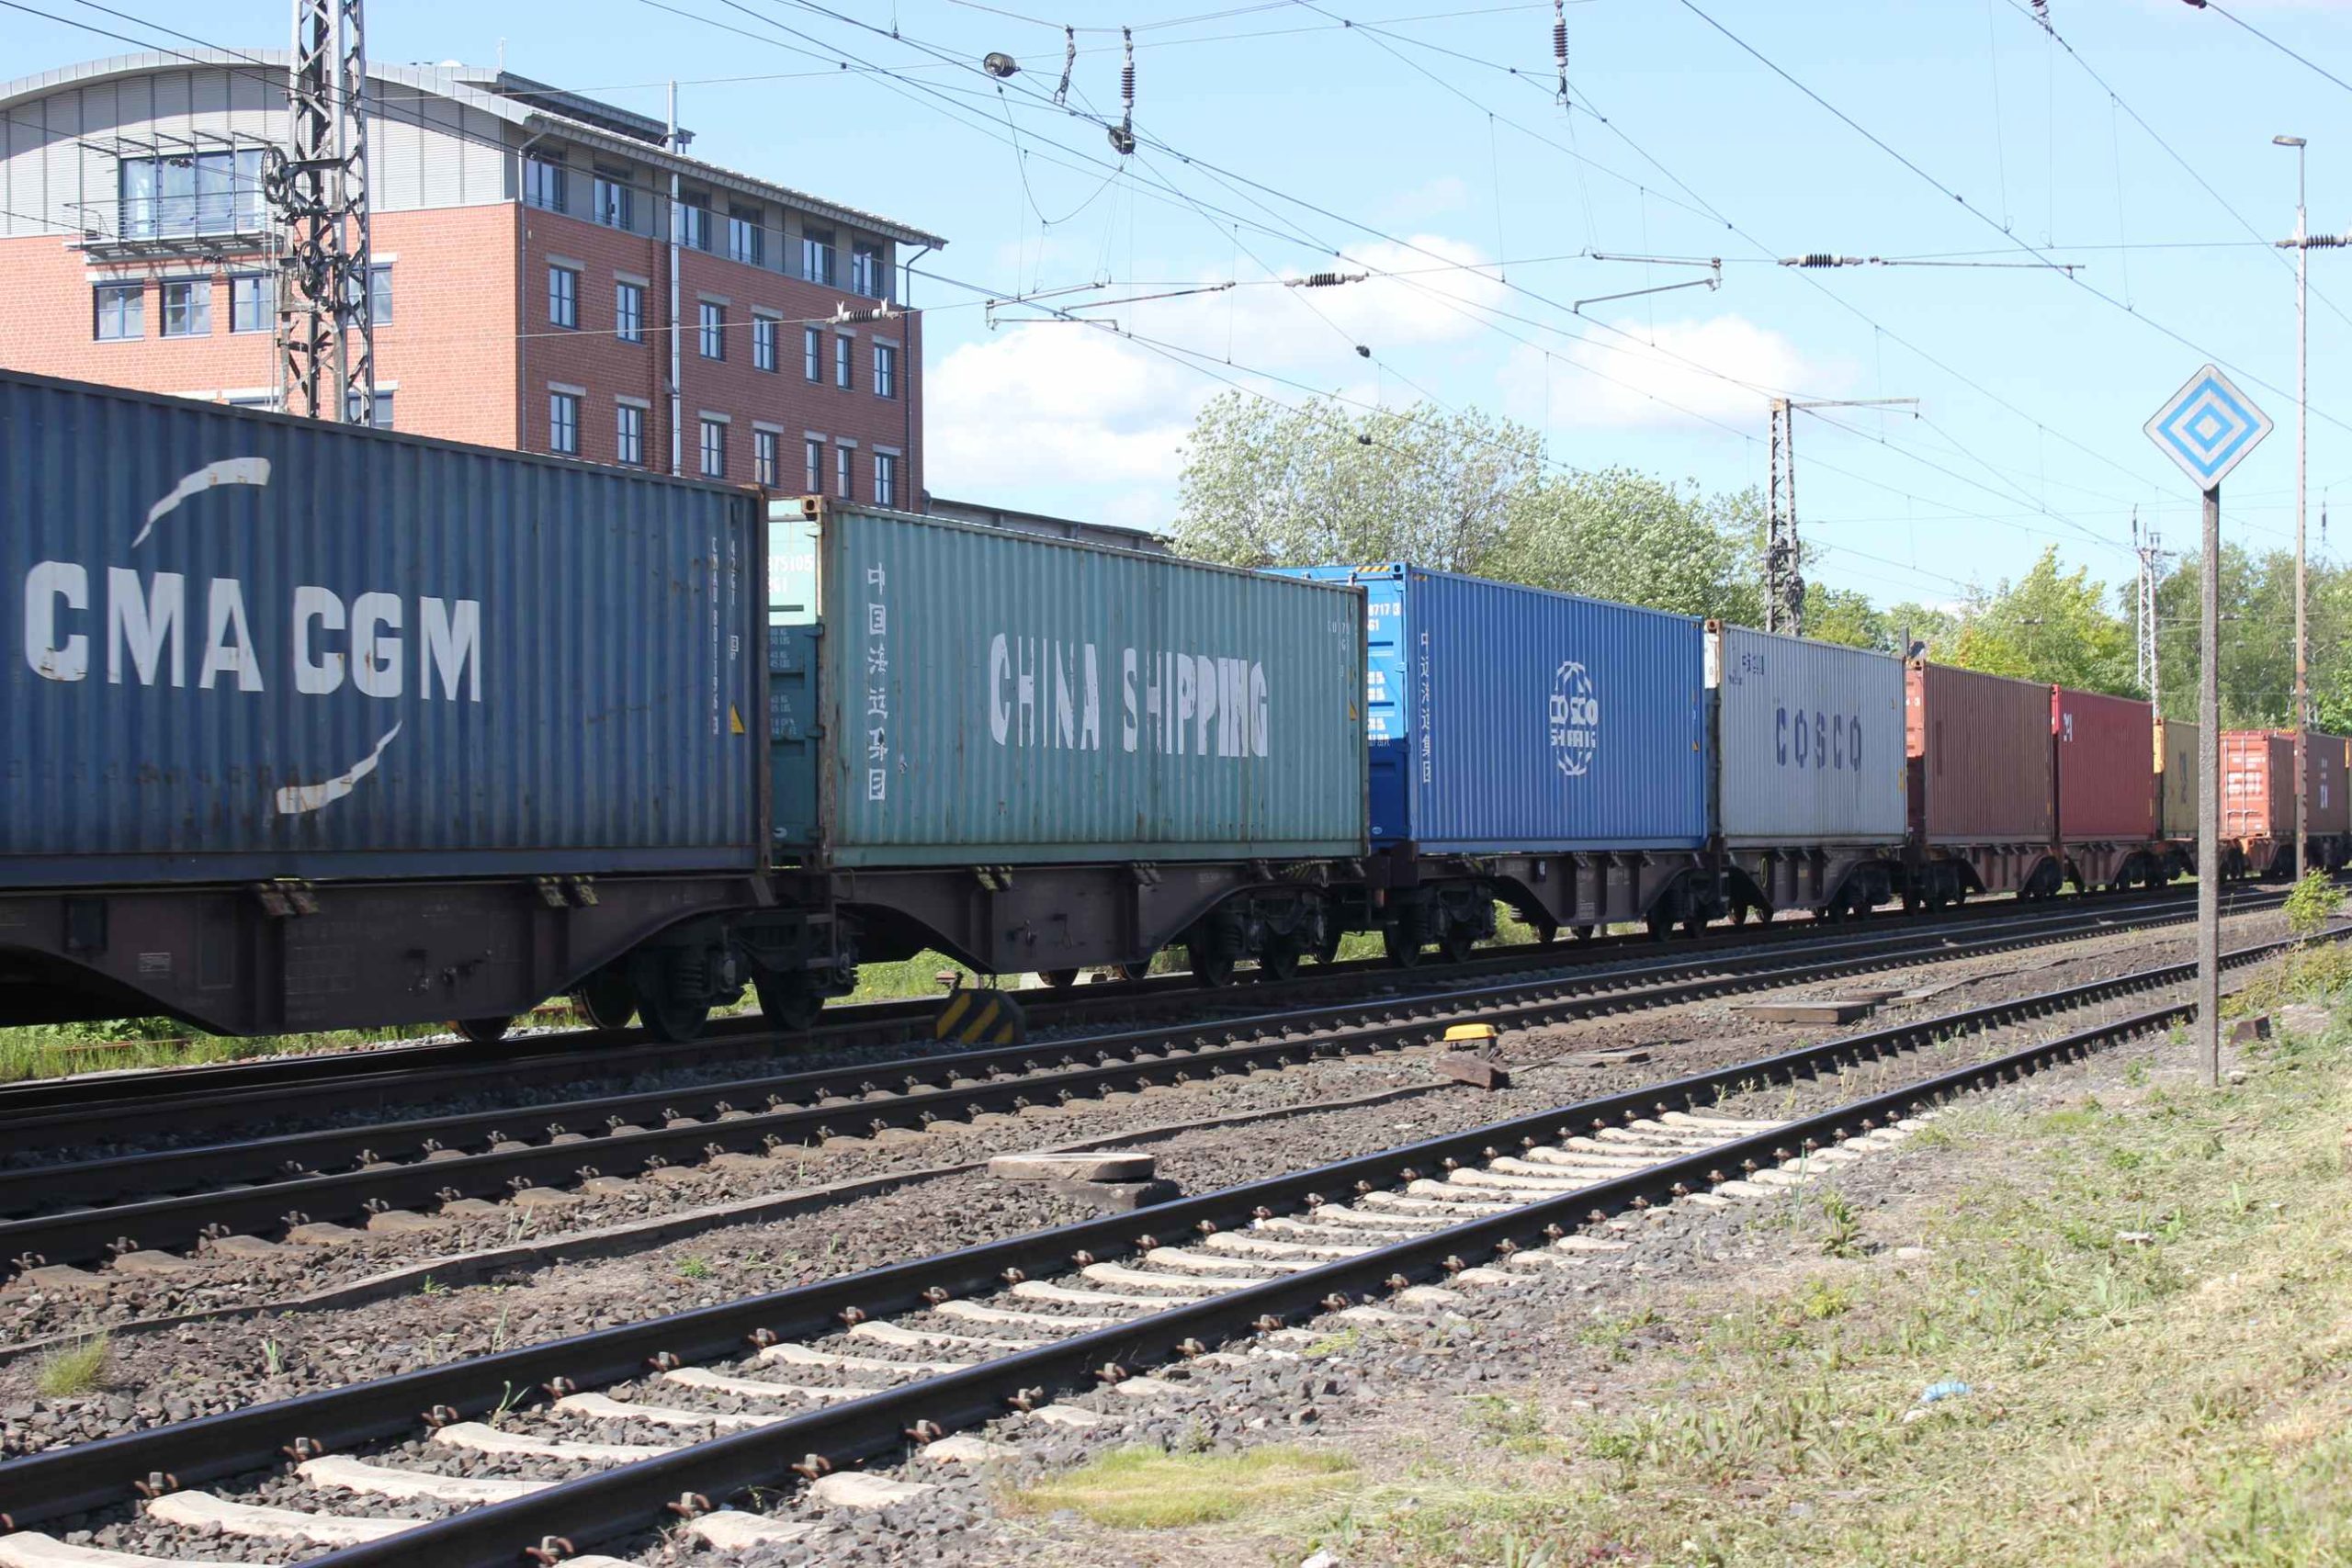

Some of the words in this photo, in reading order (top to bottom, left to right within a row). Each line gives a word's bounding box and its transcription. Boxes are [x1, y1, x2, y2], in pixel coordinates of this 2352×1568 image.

[25, 560, 264, 693] CMA
[293, 585, 482, 703] CGM
[990, 632, 1100, 750] CHINA
[1123, 647, 1268, 758] SHIPPING
[1775, 706, 1862, 773] COSCO
